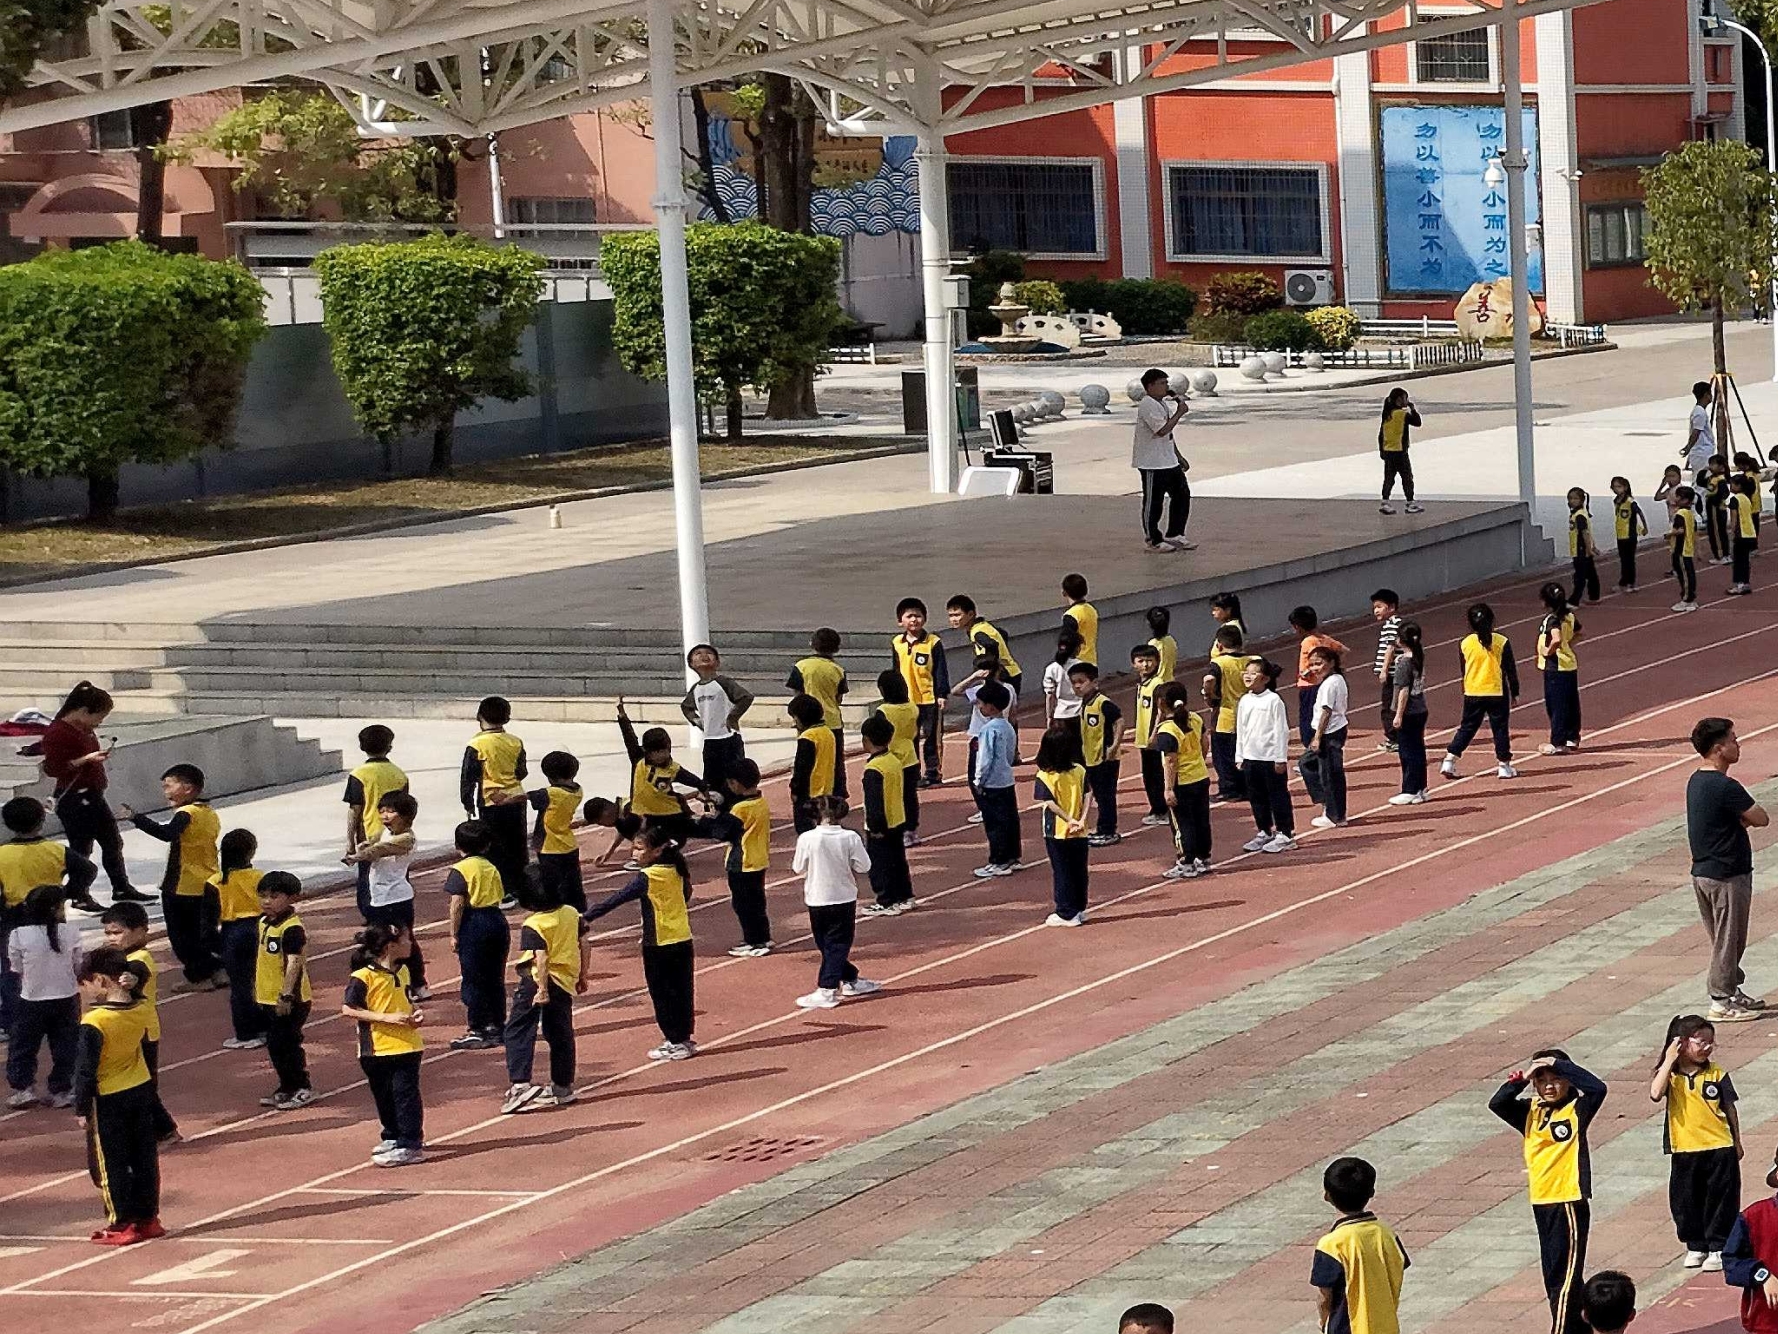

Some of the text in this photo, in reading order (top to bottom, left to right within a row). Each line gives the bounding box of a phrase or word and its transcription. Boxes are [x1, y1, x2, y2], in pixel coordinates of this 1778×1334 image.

[1414, 123, 1443, 274] 勿以善小而不为
[1479, 123, 1509, 276] 勿以小而为之
